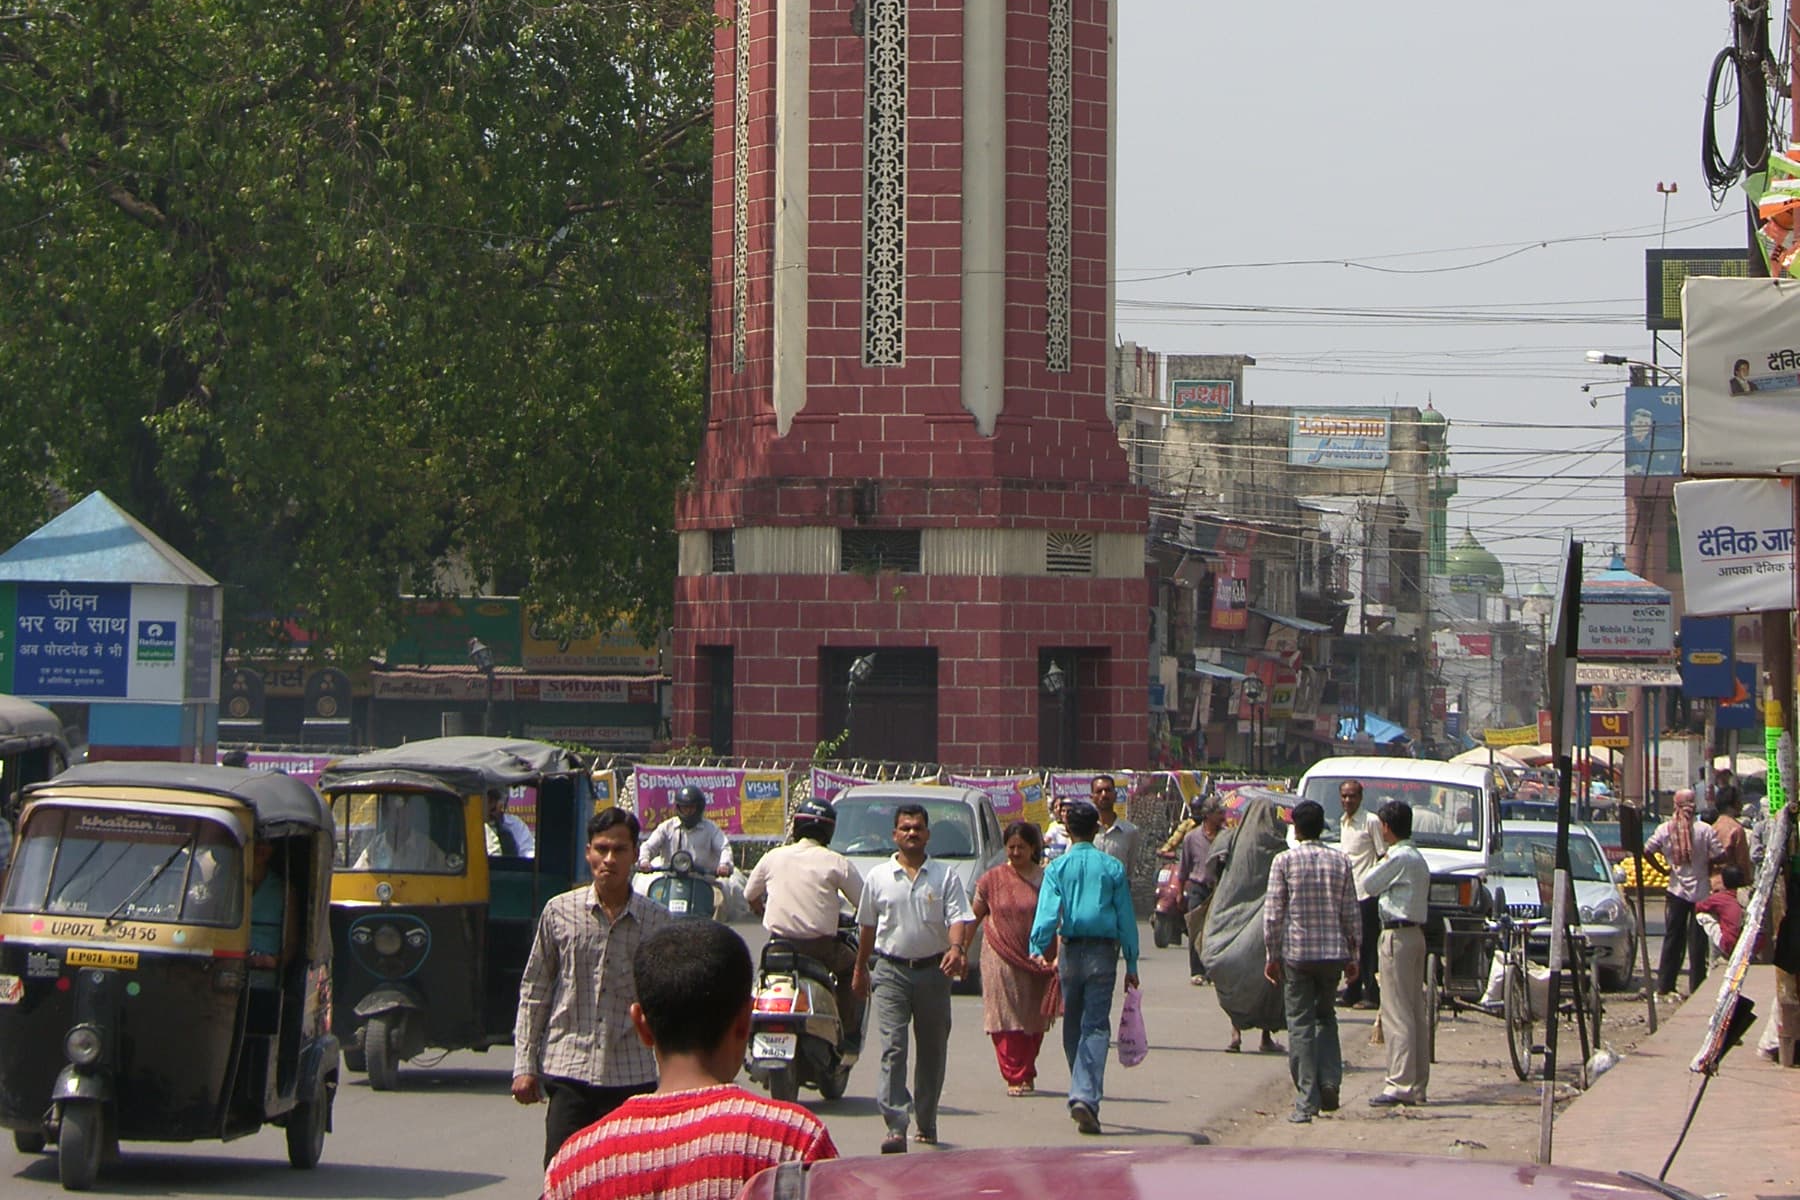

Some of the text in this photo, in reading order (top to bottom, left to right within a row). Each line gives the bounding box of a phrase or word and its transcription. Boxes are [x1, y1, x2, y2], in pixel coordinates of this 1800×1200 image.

[1697, 526, 1758, 556] दैनिक
[1718, 560, 1786, 576] आपका दैनिक
[48, 589, 99, 612] जीवन
[19, 615, 128, 635] भर का साथ
[1637, 624, 1654, 636] Long
[19, 644, 38, 656] अब
[108, 644, 122, 657] भी
[639, 772, 736, 789] Special Inaugural
[82, 816, 152, 830] khaitan
[51, 924, 157, 941] UP07L 9456
[70, 952, 105, 965] UP07L
[110, 954, 135, 966] 9456
